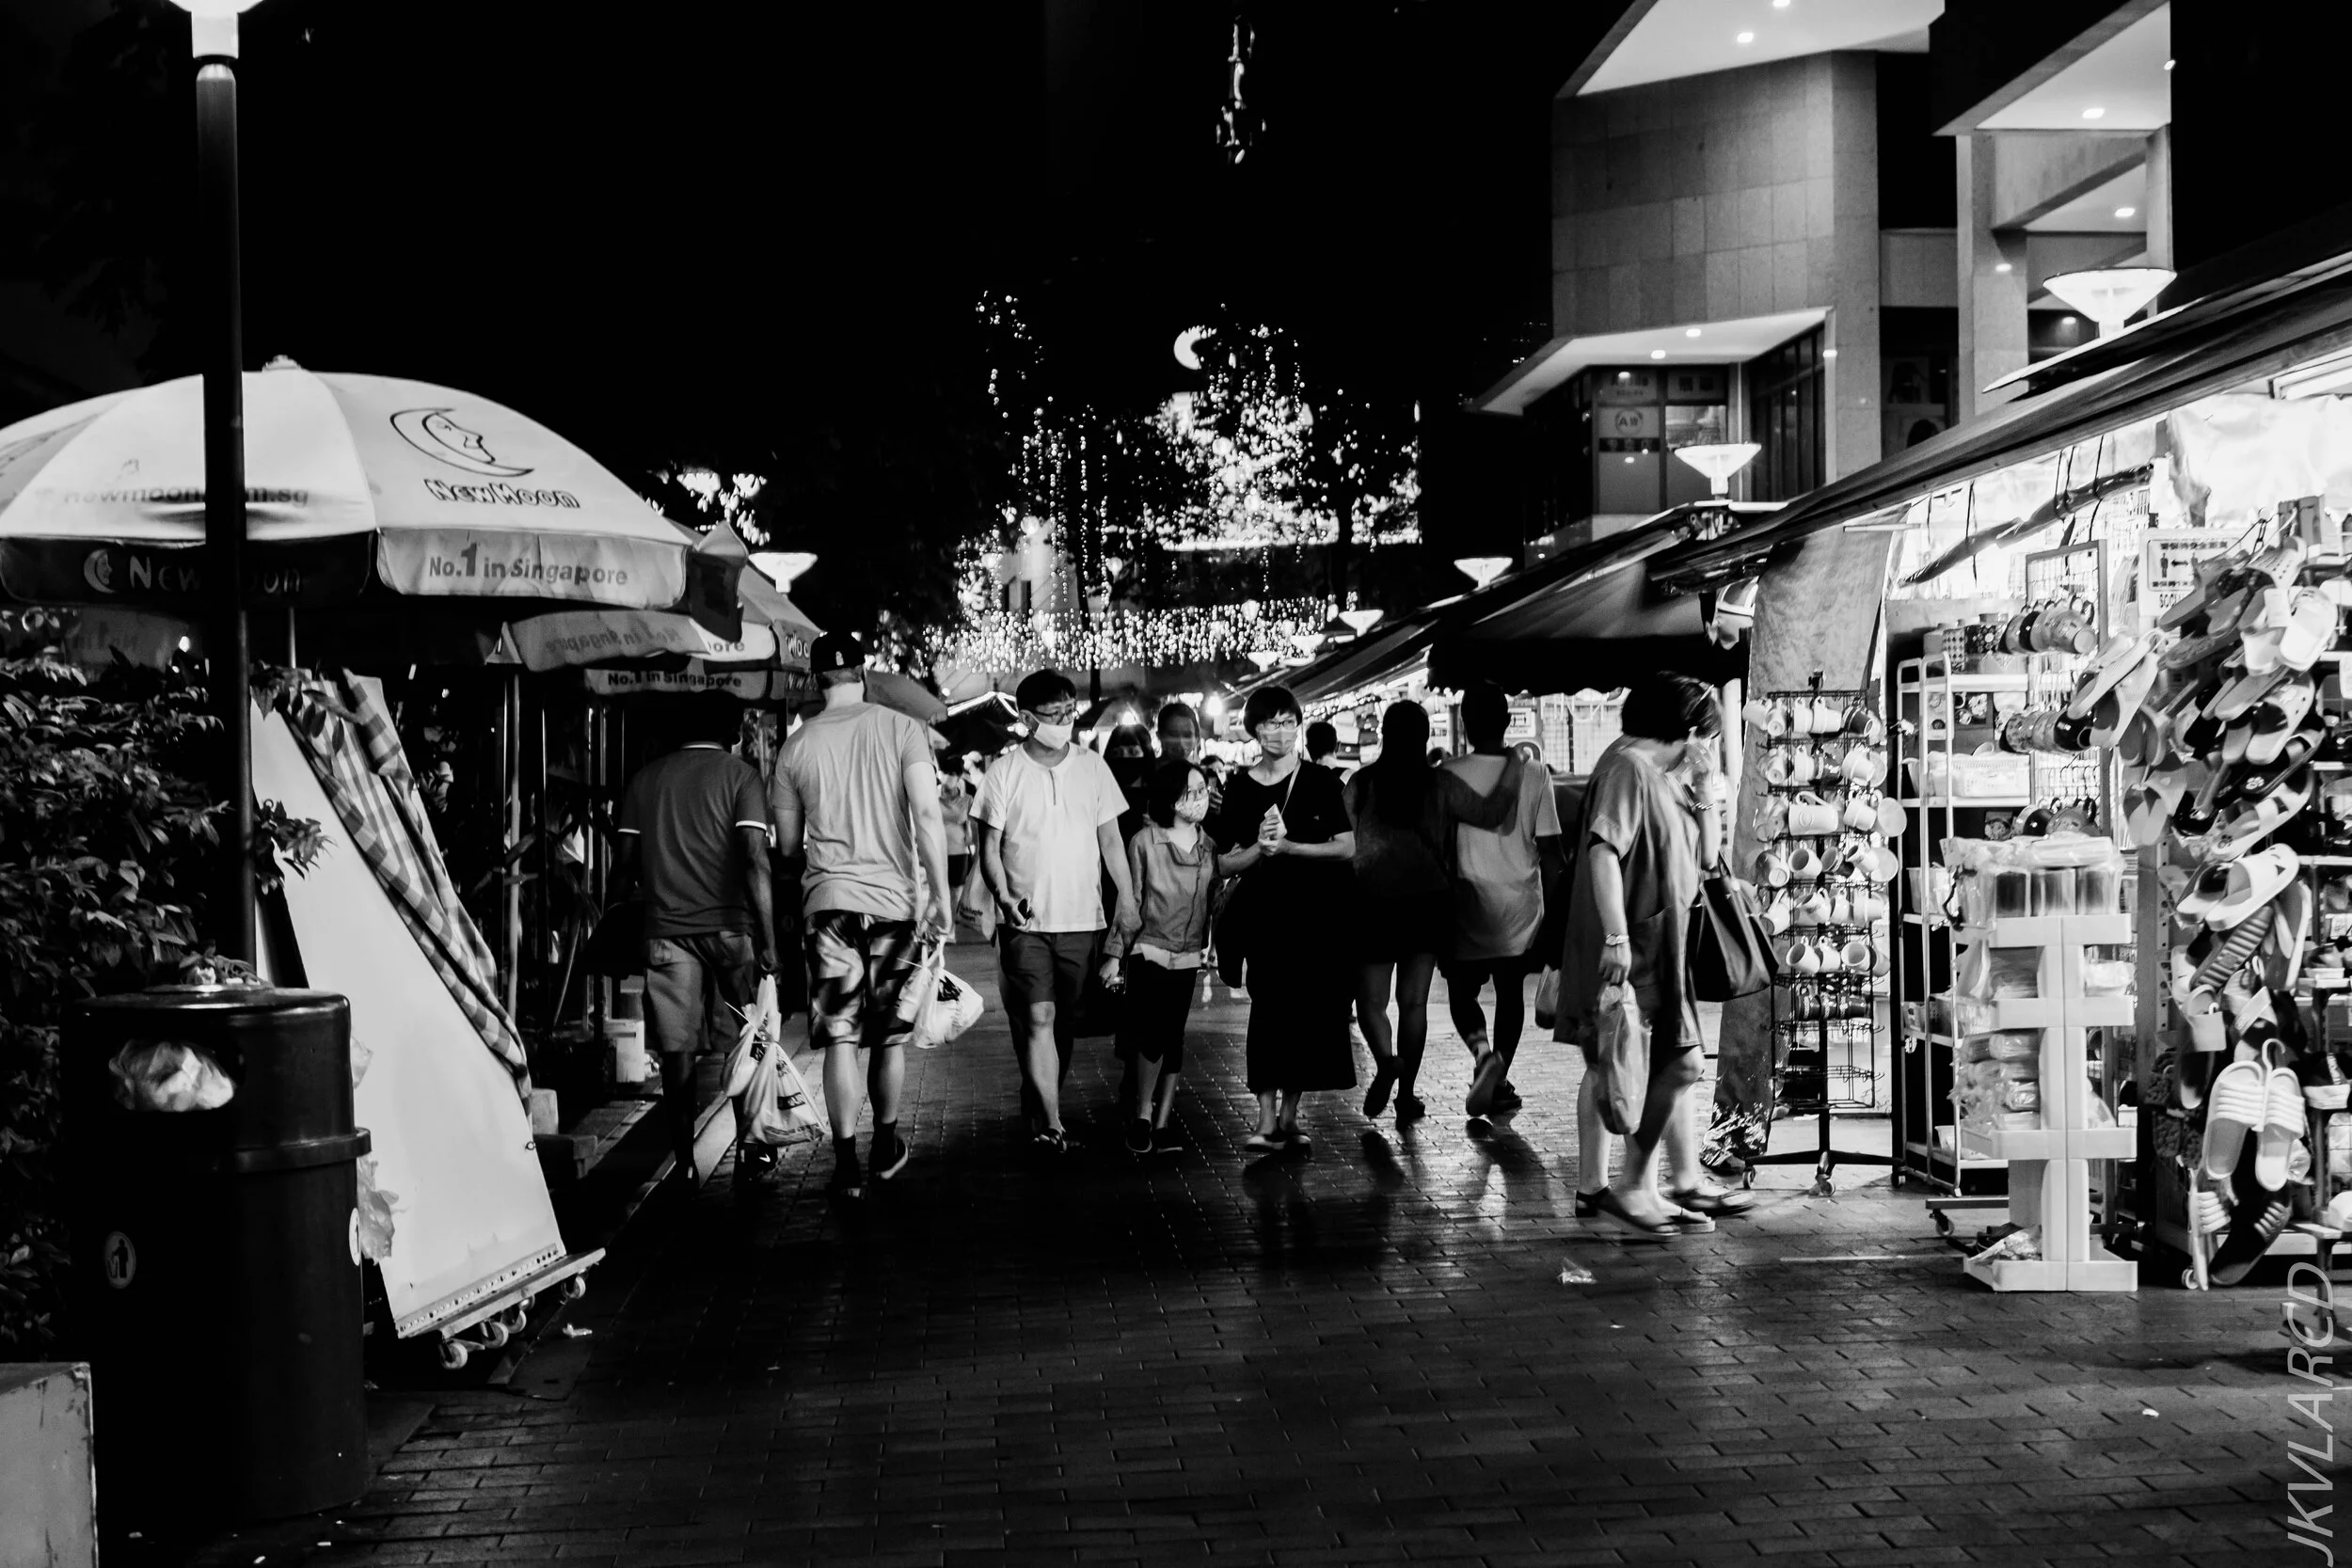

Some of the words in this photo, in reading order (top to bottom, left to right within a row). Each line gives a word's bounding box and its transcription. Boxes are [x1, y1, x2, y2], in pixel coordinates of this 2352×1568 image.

[428, 542, 478, 578] No.1
[483, 557, 506, 579] in
[512, 558, 628, 585] Singapore
[663, 671, 742, 689] Singapore
